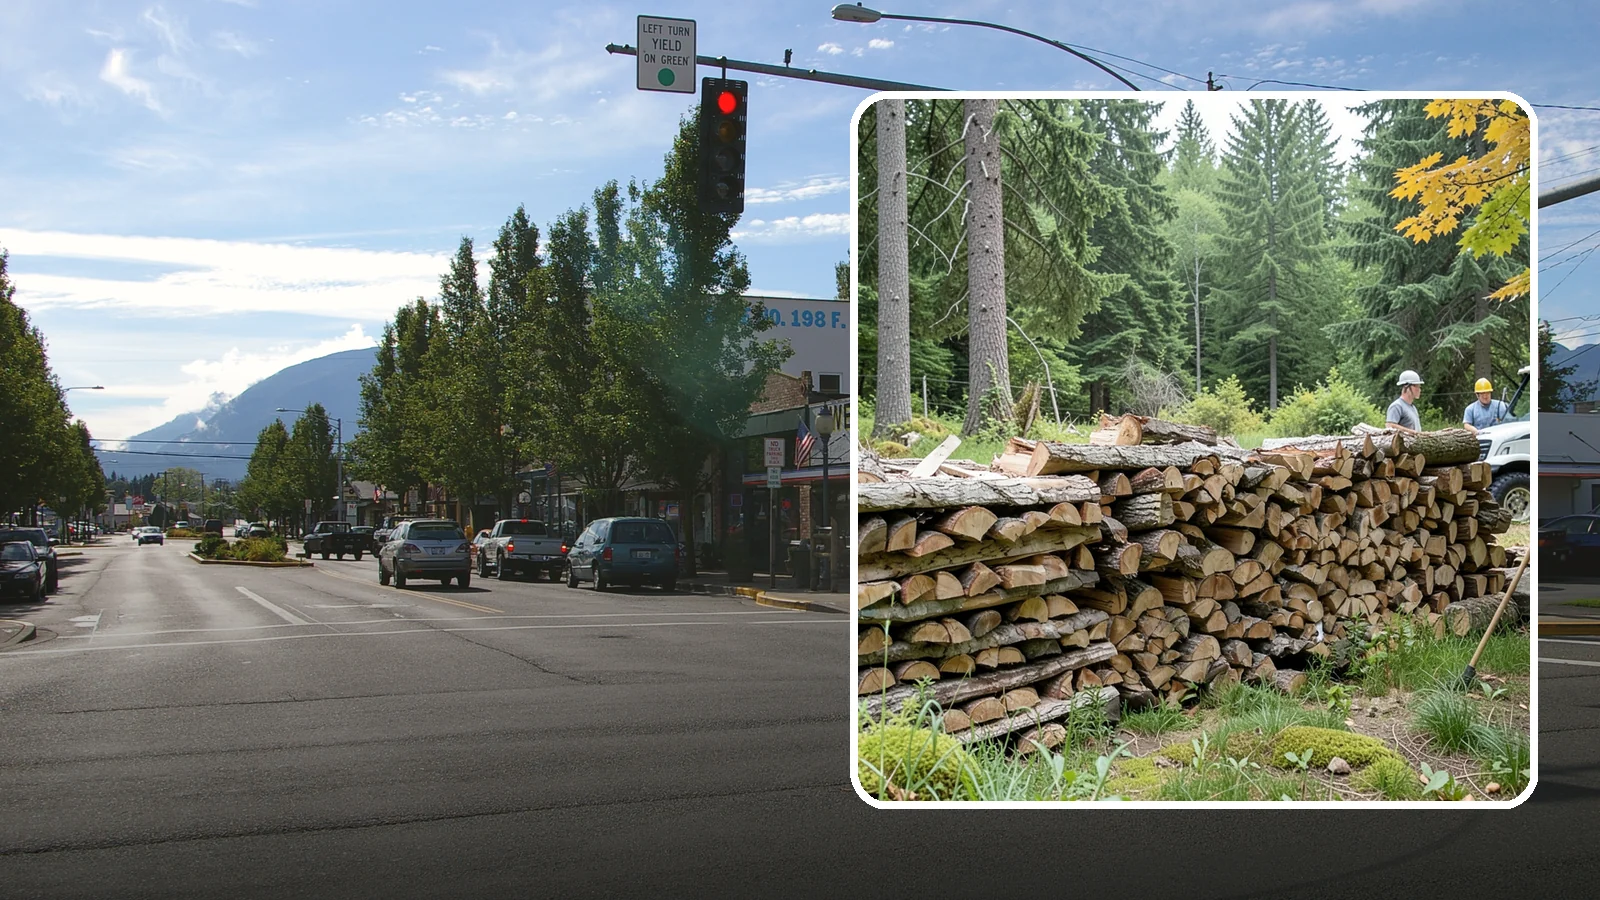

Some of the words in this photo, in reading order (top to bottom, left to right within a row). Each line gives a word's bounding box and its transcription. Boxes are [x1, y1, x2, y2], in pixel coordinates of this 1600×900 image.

[643, 23, 663, 34] LEFT
[668, 25, 690, 37] TURN
[652, 37, 682, 52] YIELD
[644, 53, 656, 64] ON
[661, 54, 689, 66] GREEN
[791, 309, 826, 328] 198
[831, 311, 847, 329] F.
